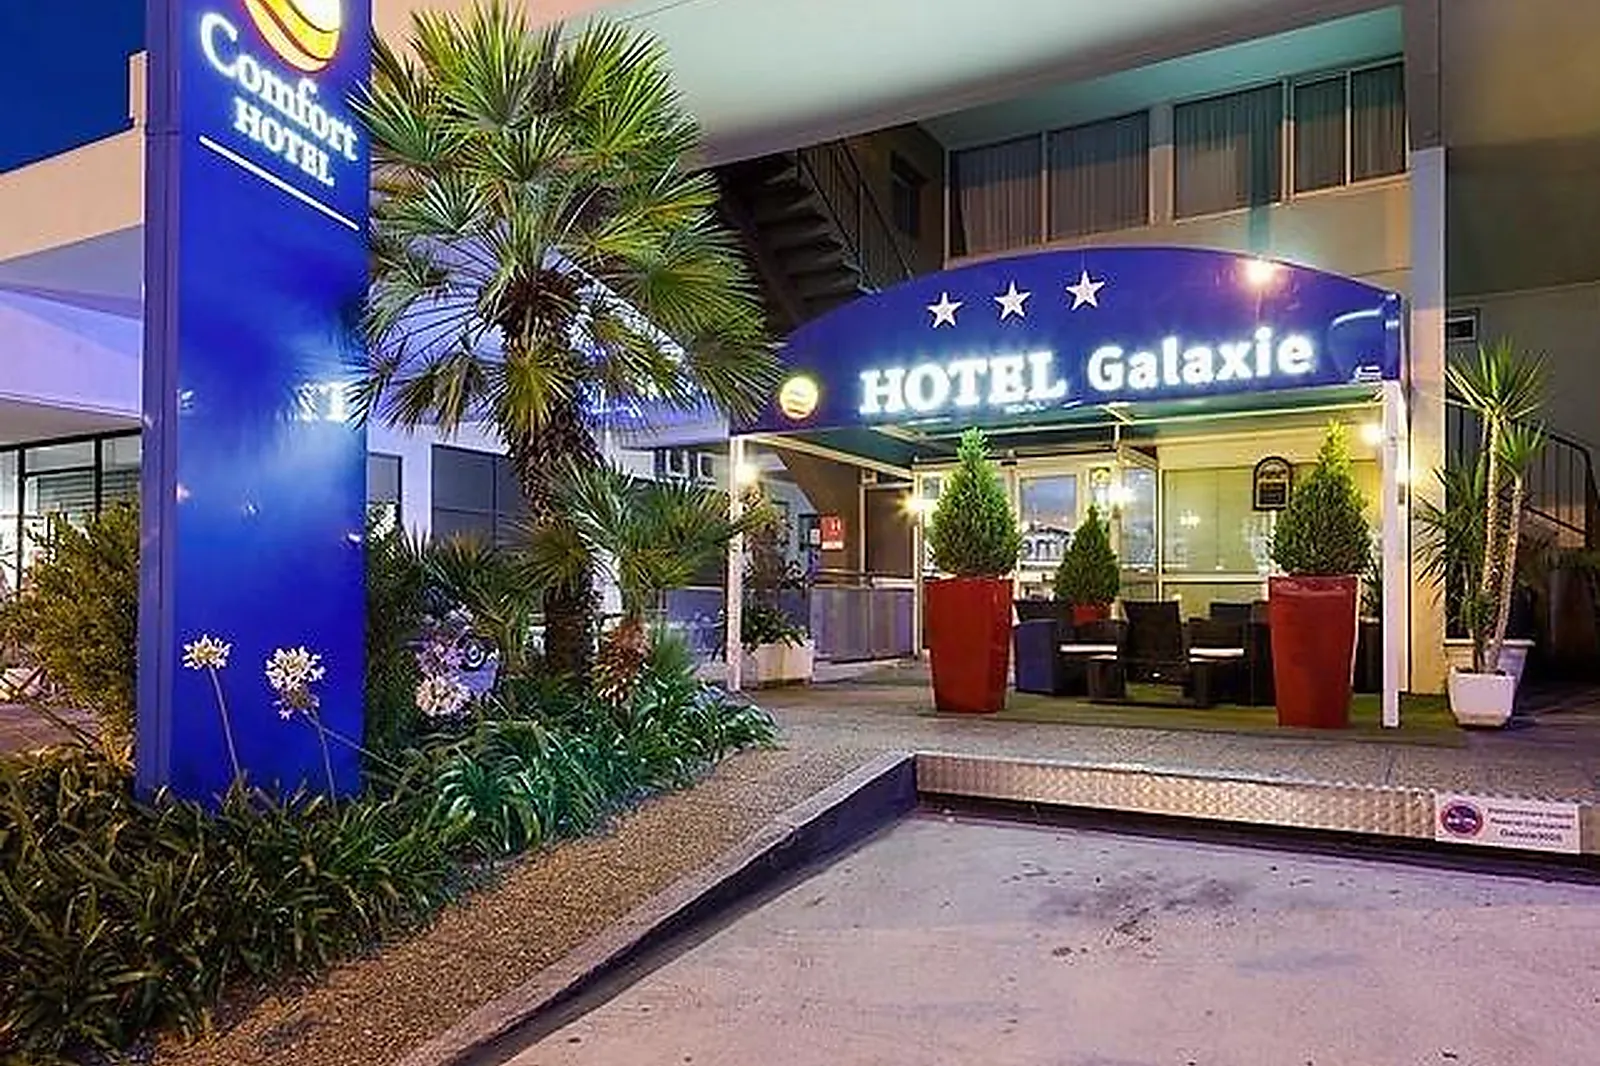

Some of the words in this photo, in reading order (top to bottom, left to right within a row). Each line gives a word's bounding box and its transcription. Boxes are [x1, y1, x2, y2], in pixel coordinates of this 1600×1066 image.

[199, 12, 359, 162] Comfort
[233, 97, 335, 187] HOTEL
[858, 351, 1068, 414] HOTEL
[1087, 325, 1316, 392] Galaxie
